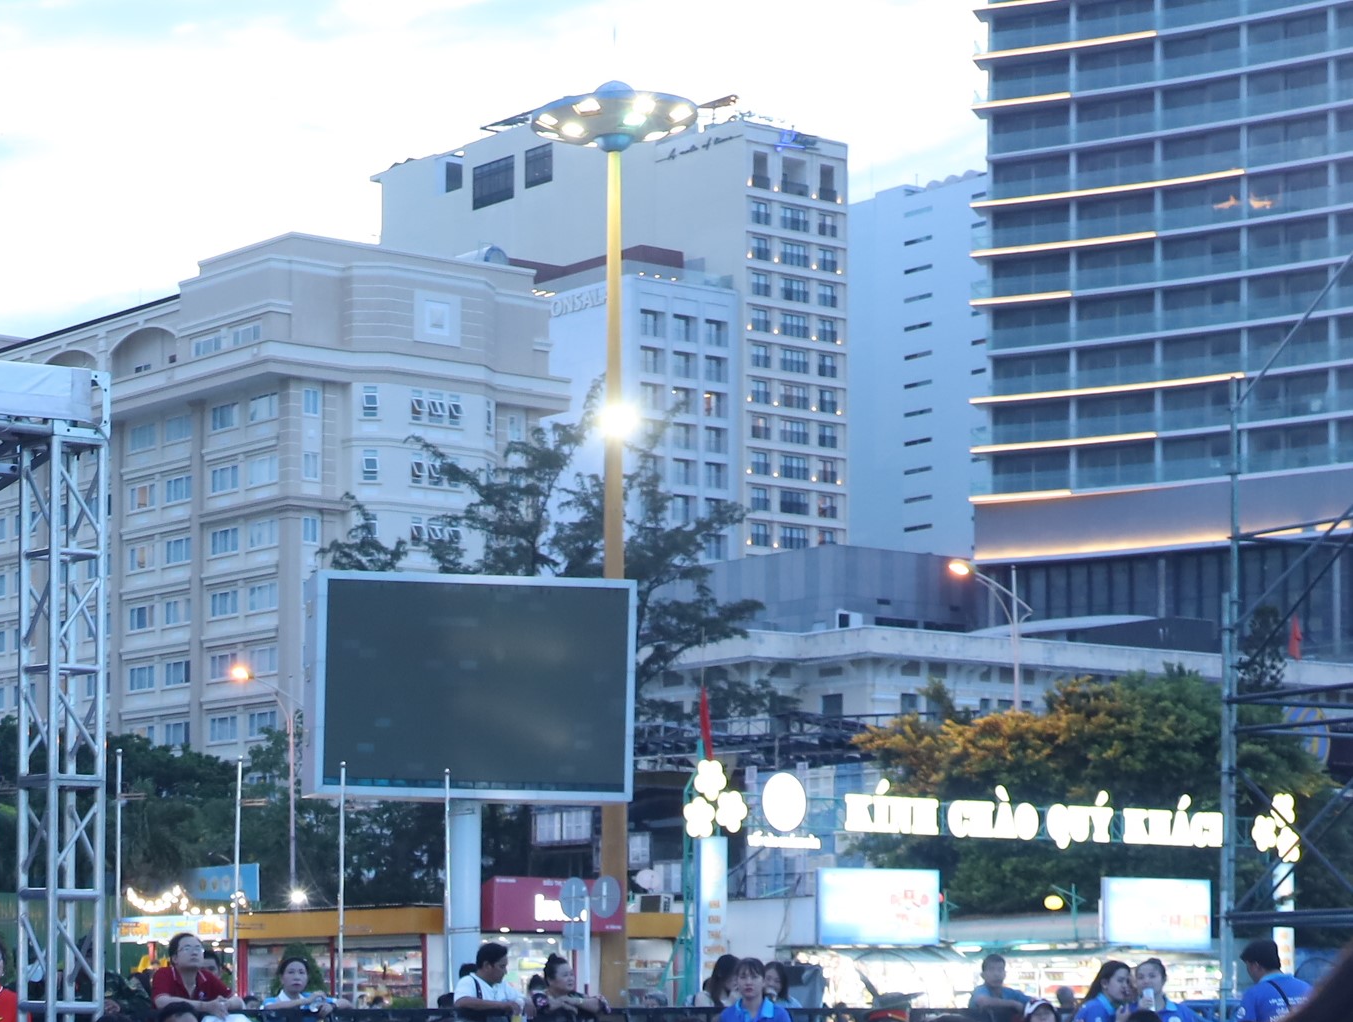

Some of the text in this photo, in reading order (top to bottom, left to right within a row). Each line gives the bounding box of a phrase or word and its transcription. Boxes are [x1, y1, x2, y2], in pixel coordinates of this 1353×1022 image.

[844, 778, 940, 836] KÍNH
[947, 784, 1040, 841] CHÀO
[1046, 789, 1114, 850] QUÝ
